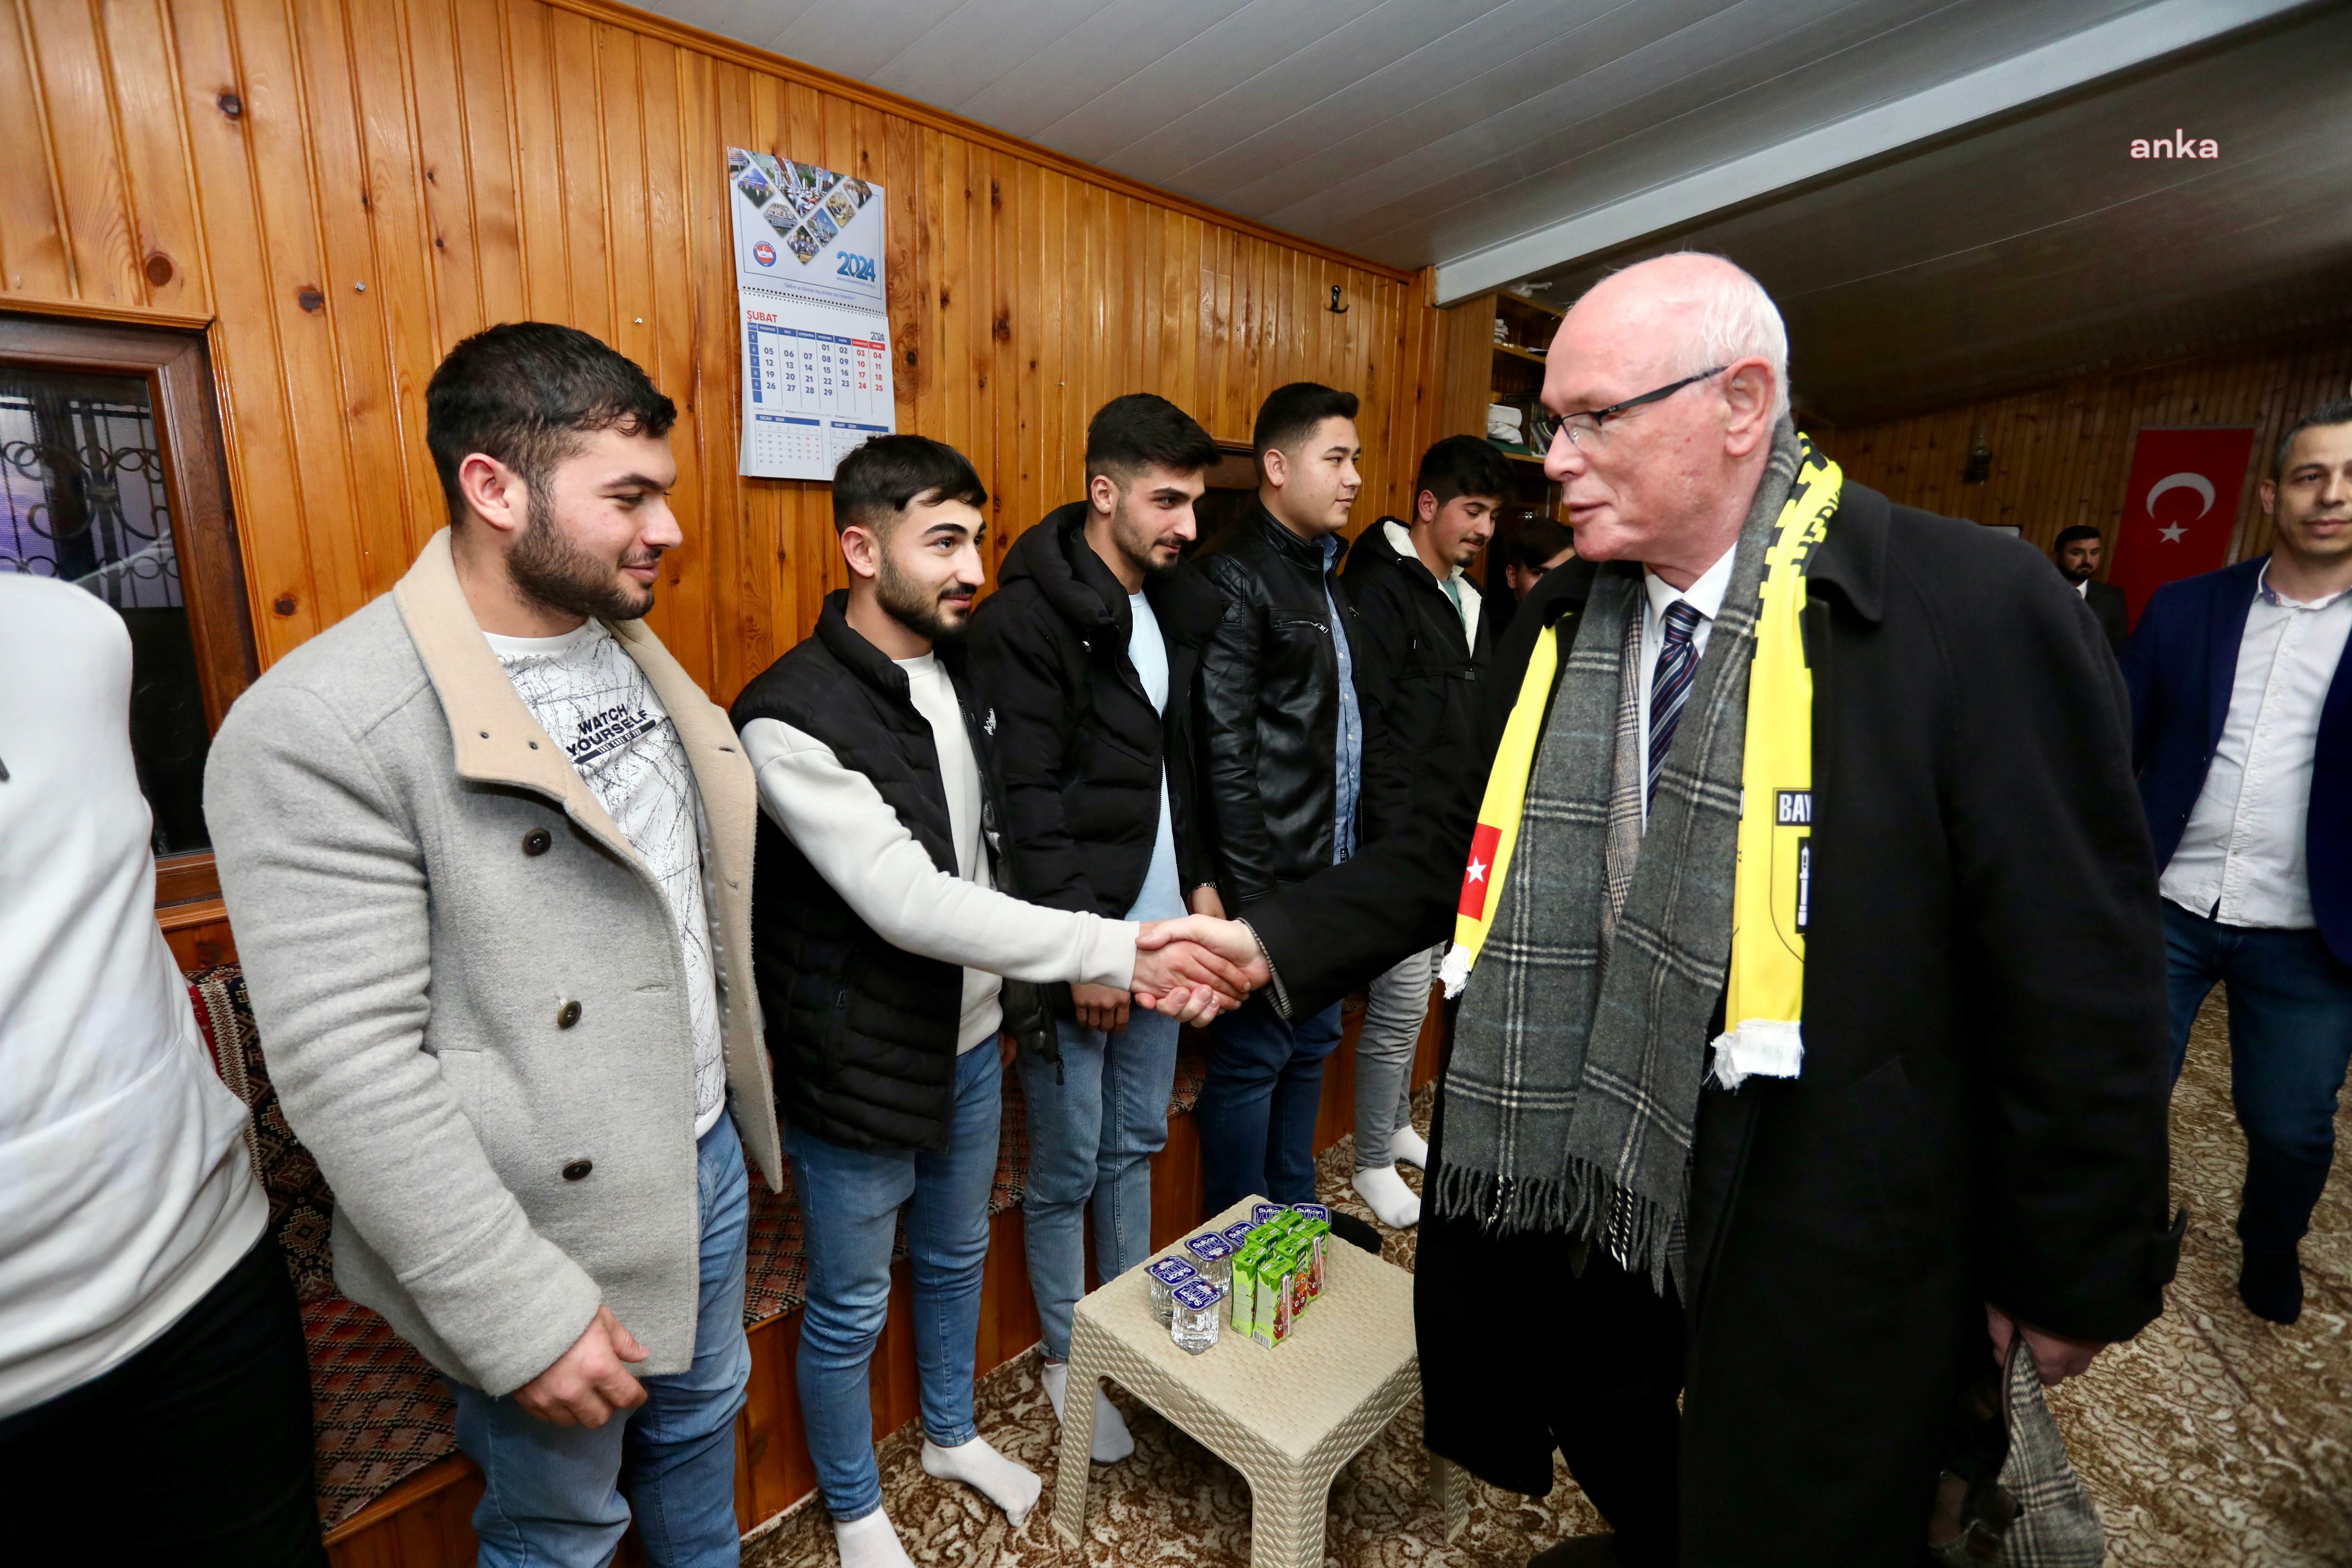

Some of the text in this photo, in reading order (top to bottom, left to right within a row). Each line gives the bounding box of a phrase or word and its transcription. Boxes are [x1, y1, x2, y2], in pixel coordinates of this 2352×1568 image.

[837, 251, 876, 282] 2024
[747, 310, 777, 323] ŞUBAT
[871, 332, 884, 341] 2024
[578, 703, 628, 735] WATCH
[566, 710, 647, 756] YOURSELF
[597, 744, 612, 754] TAKE
[611, 738, 626, 747] CARE
[1229, 1226, 1251, 1238] Sultan
[1193, 1236, 1217, 1248] Sultan
[1166, 1268, 1191, 1281] Sultan
[1179, 1290, 1202, 1306] Sultan
